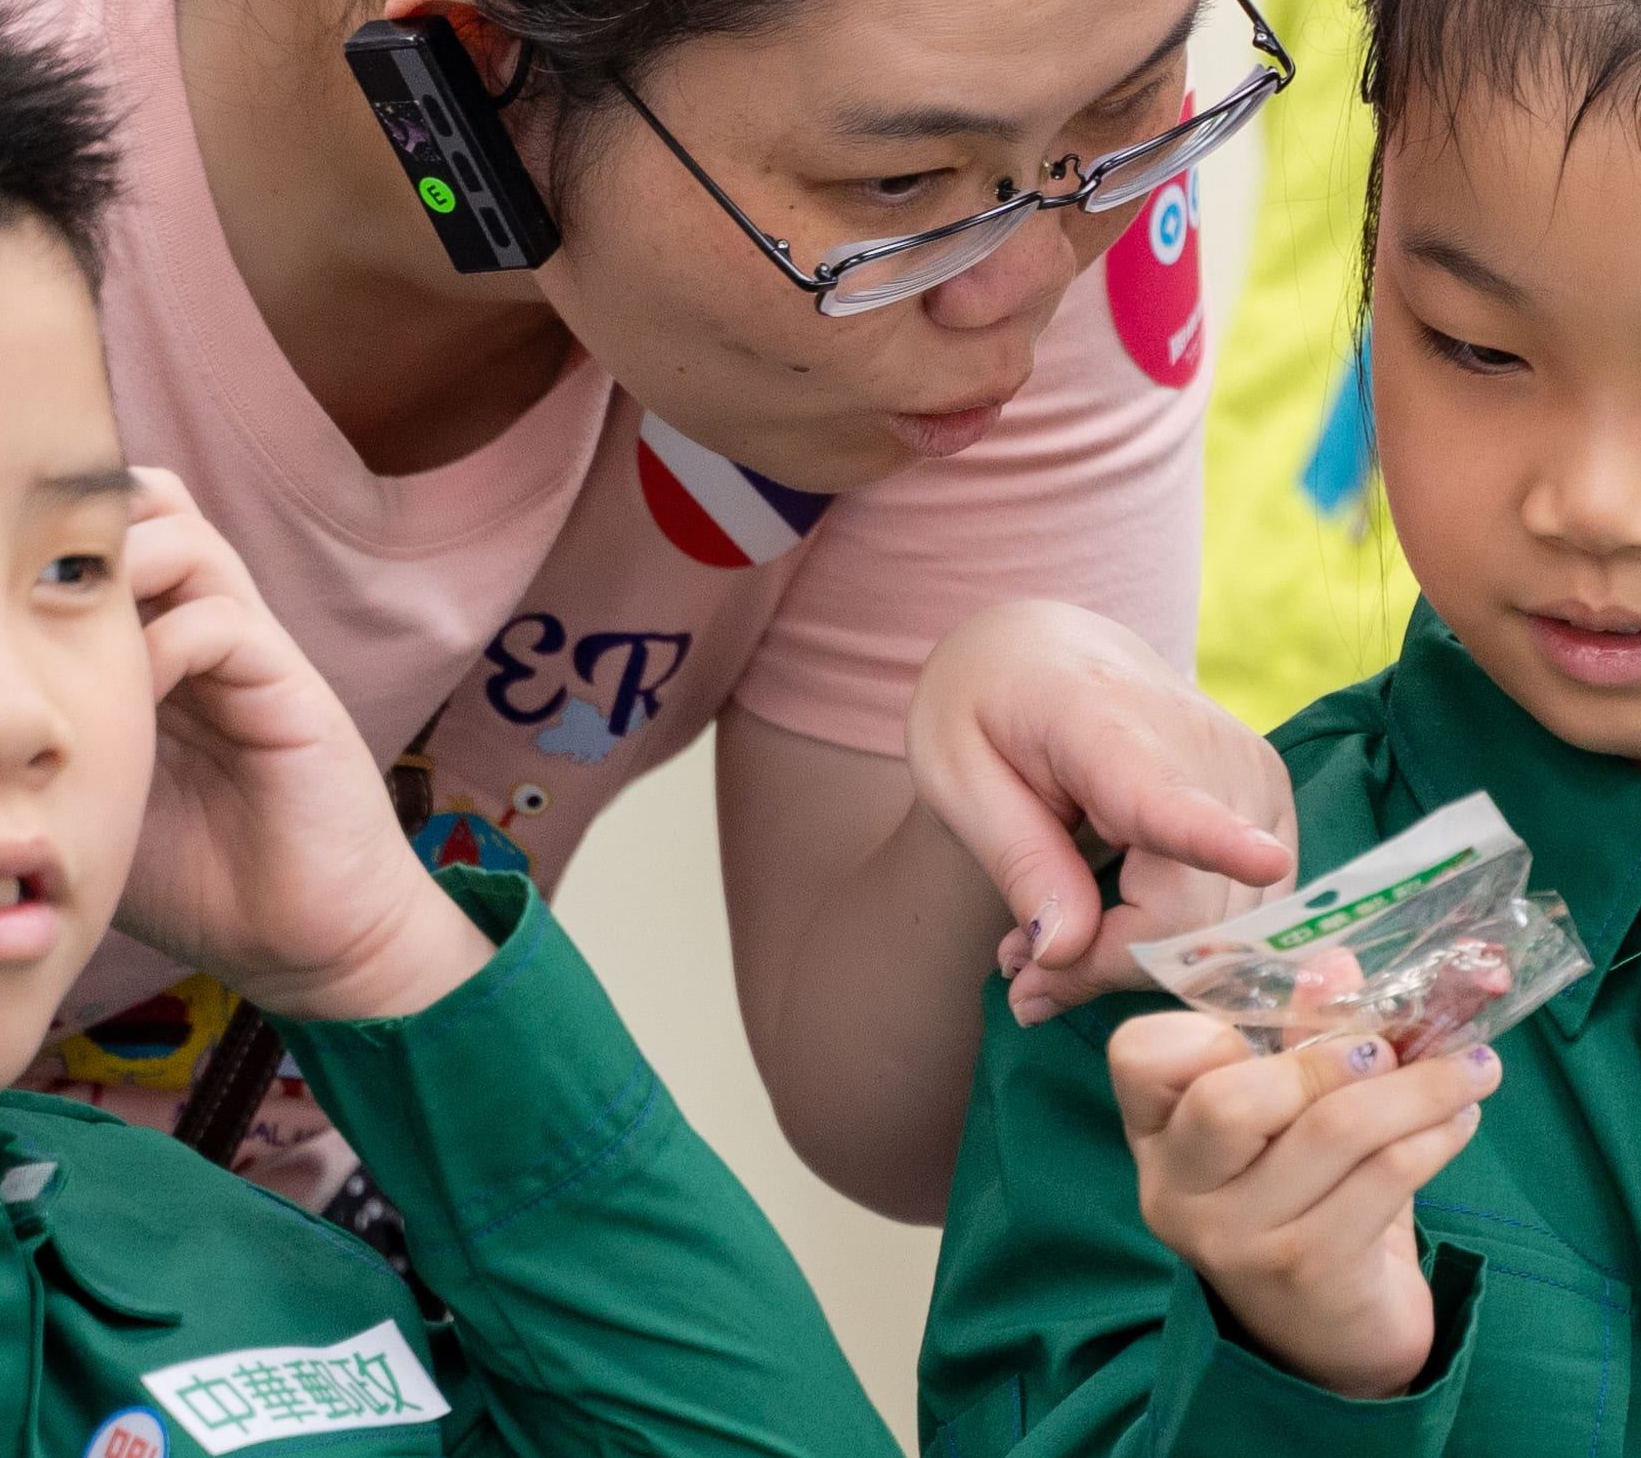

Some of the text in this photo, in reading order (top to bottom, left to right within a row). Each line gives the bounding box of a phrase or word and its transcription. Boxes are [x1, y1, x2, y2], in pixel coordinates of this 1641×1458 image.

[426, 185, 448, 206] E
[174, 1349, 424, 1434] 中華郵政
